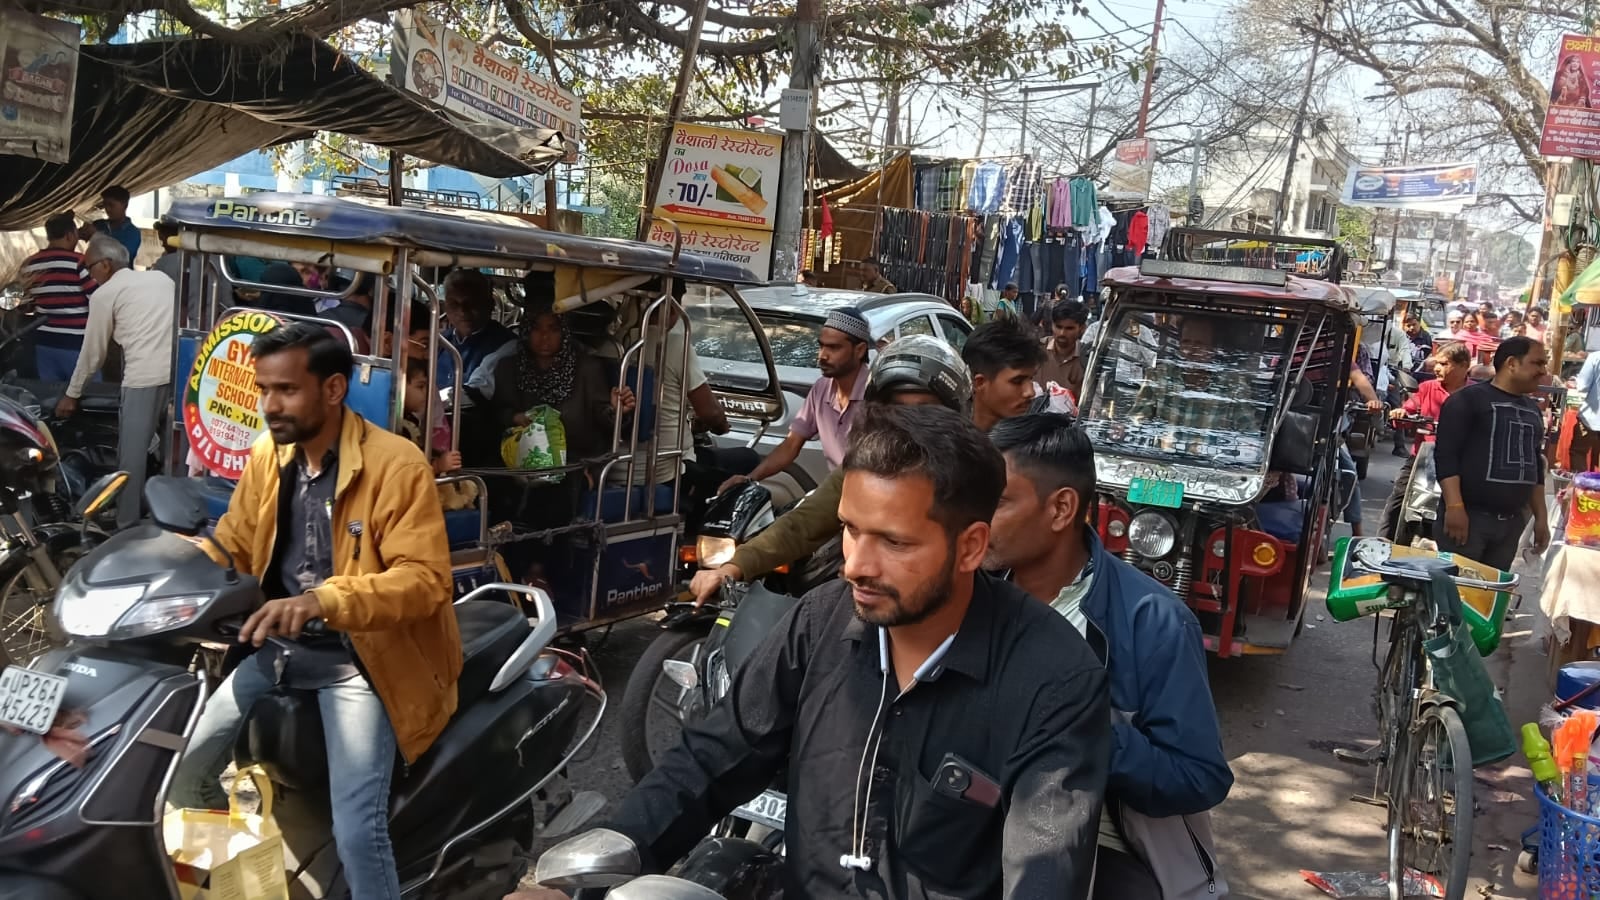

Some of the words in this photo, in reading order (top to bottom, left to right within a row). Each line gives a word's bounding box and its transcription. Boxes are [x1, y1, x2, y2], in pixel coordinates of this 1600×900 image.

[490, 84, 525, 115] FAMILY
[675, 129, 718, 150] वैशाली
[720, 136, 776, 157] रेस्टोरेन्ट
[668, 157, 709, 175] Dosa
[677, 182, 713, 207] 70/-
[216, 383, 259, 412] SCHOOL
[208, 400, 233, 418] PNC
[241, 412, 258, 429] XII
[607, 581, 662, 606] Panther
